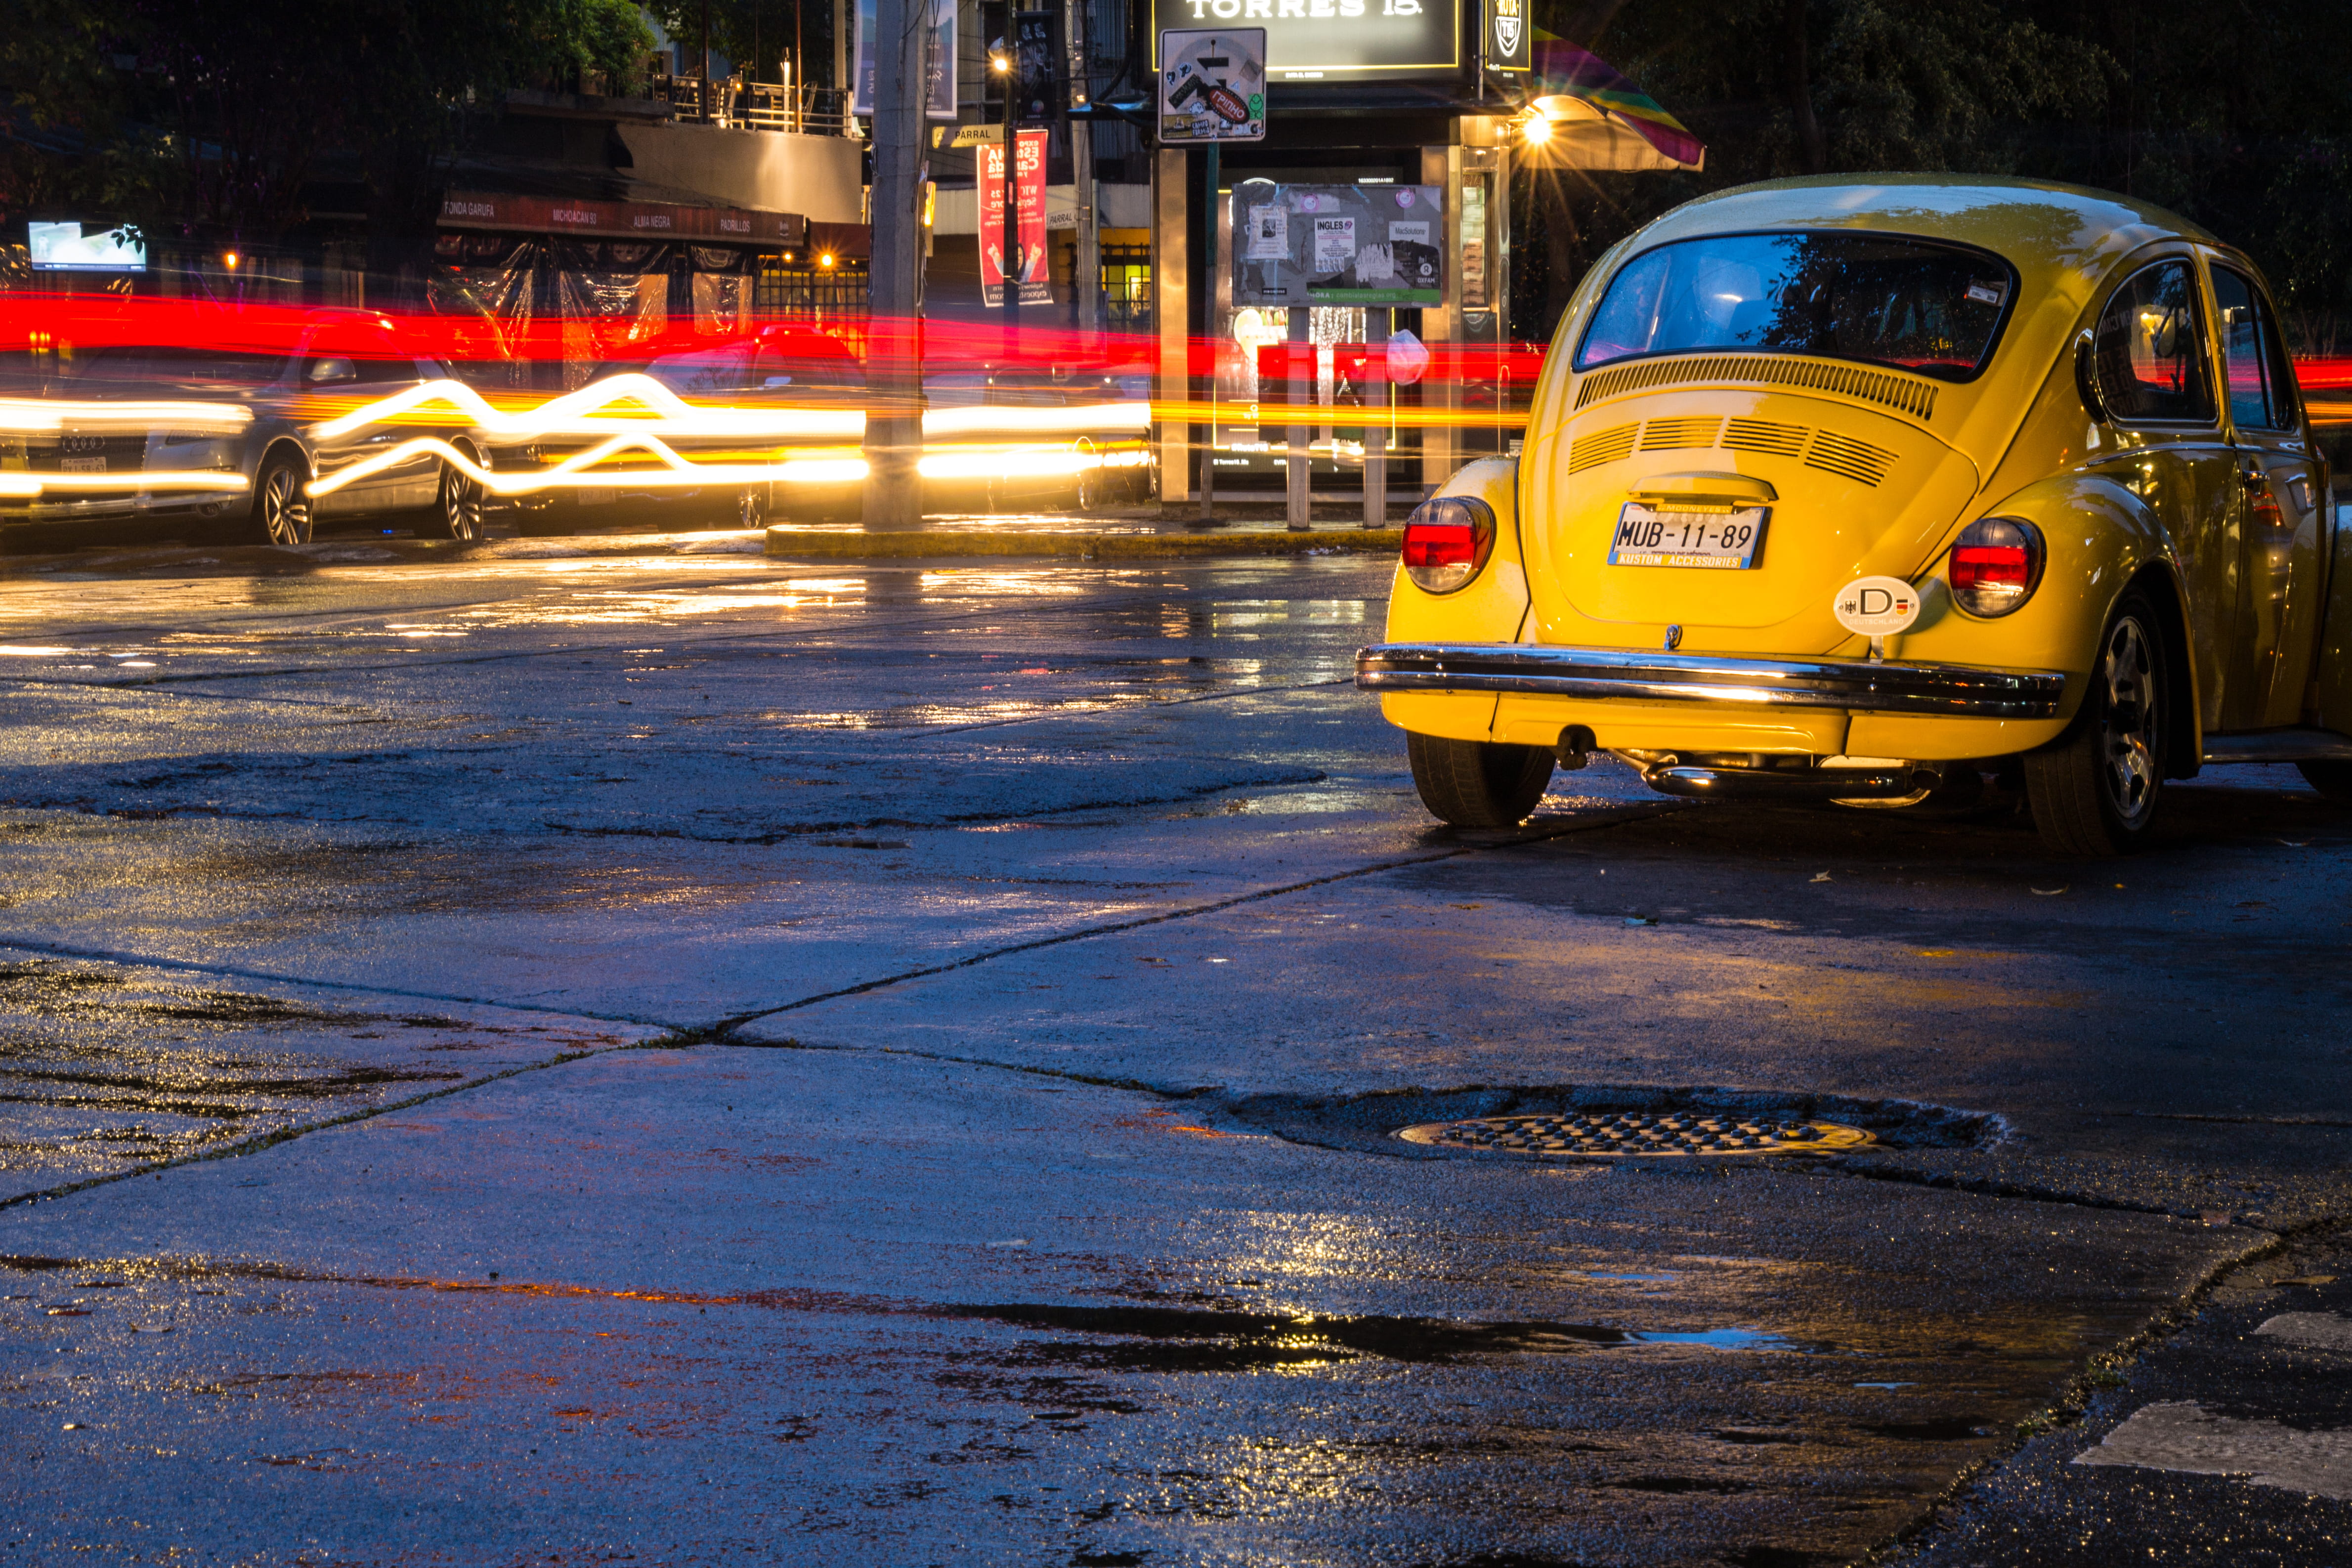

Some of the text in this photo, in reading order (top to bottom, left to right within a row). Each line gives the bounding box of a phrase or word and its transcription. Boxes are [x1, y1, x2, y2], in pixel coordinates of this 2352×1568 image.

[1190, 0, 1365, 18] TORRES
[955, 129, 990, 139] PARRAL
[444, 202, 494, 217] FONDA GARUFA
[553, 209, 596, 225] MICHOACAN 93
[634, 215, 671, 228] ALMA NEGRA
[1049, 212, 1072, 225] PARRAL
[720, 218, 750, 232] PADRILLOS
[1317, 221, 1343, 230] INGLES
[1617, 521, 1752, 549] MUB-11-89
[1619, 553, 1739, 567] KUSTOM ACCESSORIES
[1860, 589, 1892, 615] D
